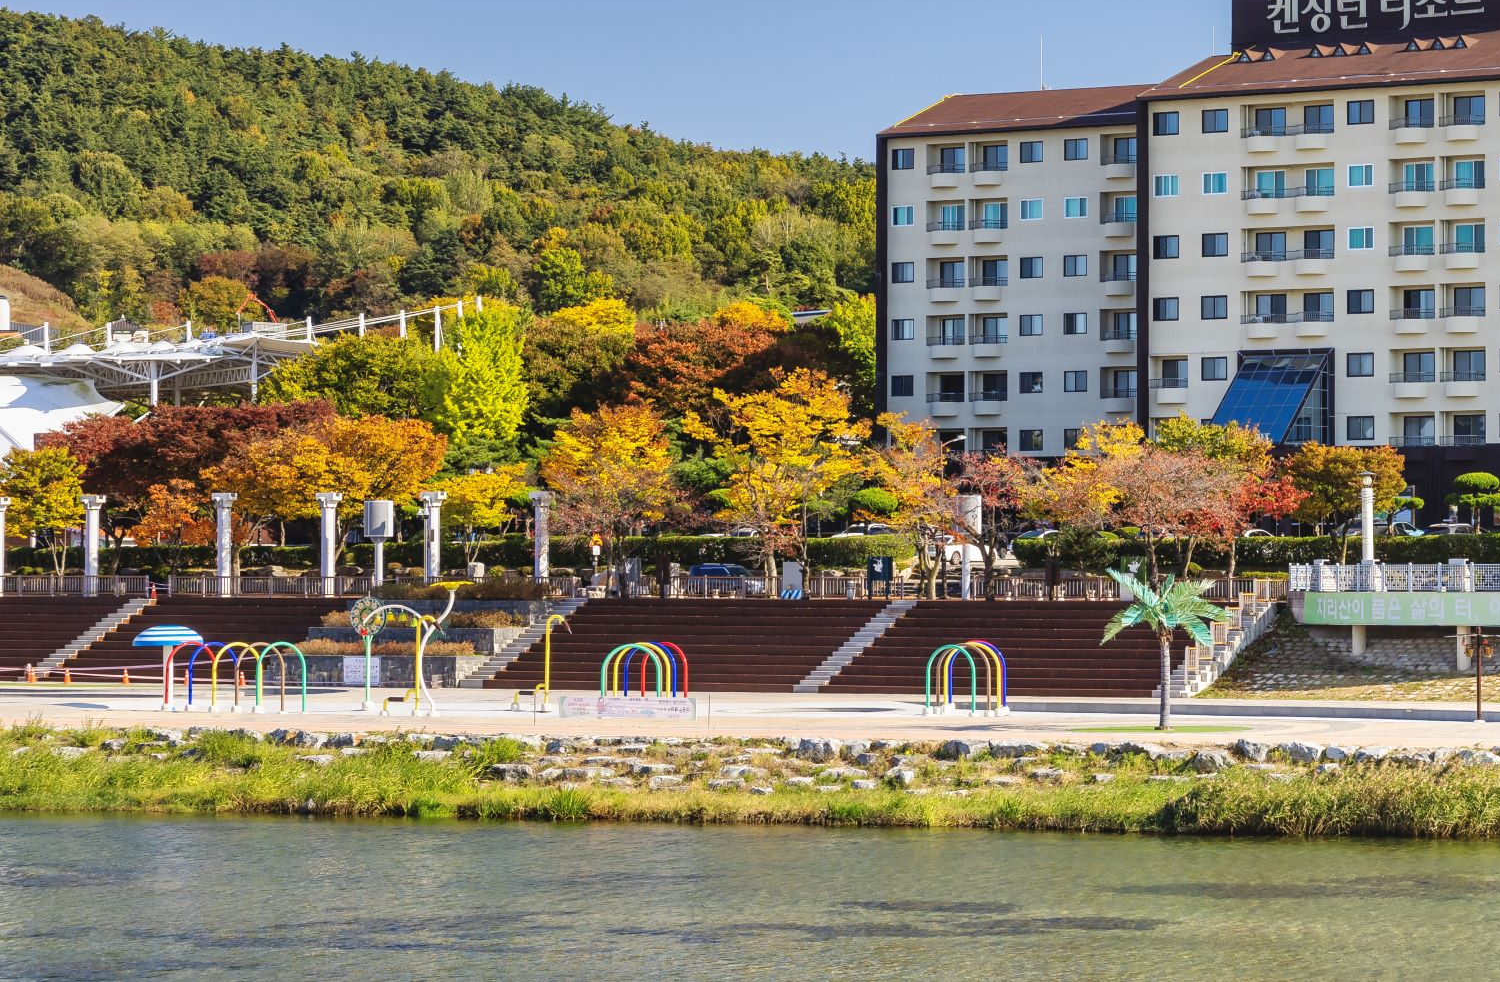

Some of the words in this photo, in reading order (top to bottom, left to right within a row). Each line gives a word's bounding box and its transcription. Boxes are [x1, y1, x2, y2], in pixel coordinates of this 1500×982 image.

[1316, 597, 1365, 619] 지리산이
[1371, 597, 1402, 620] 품은
[1410, 597, 1445, 619] 삶의
